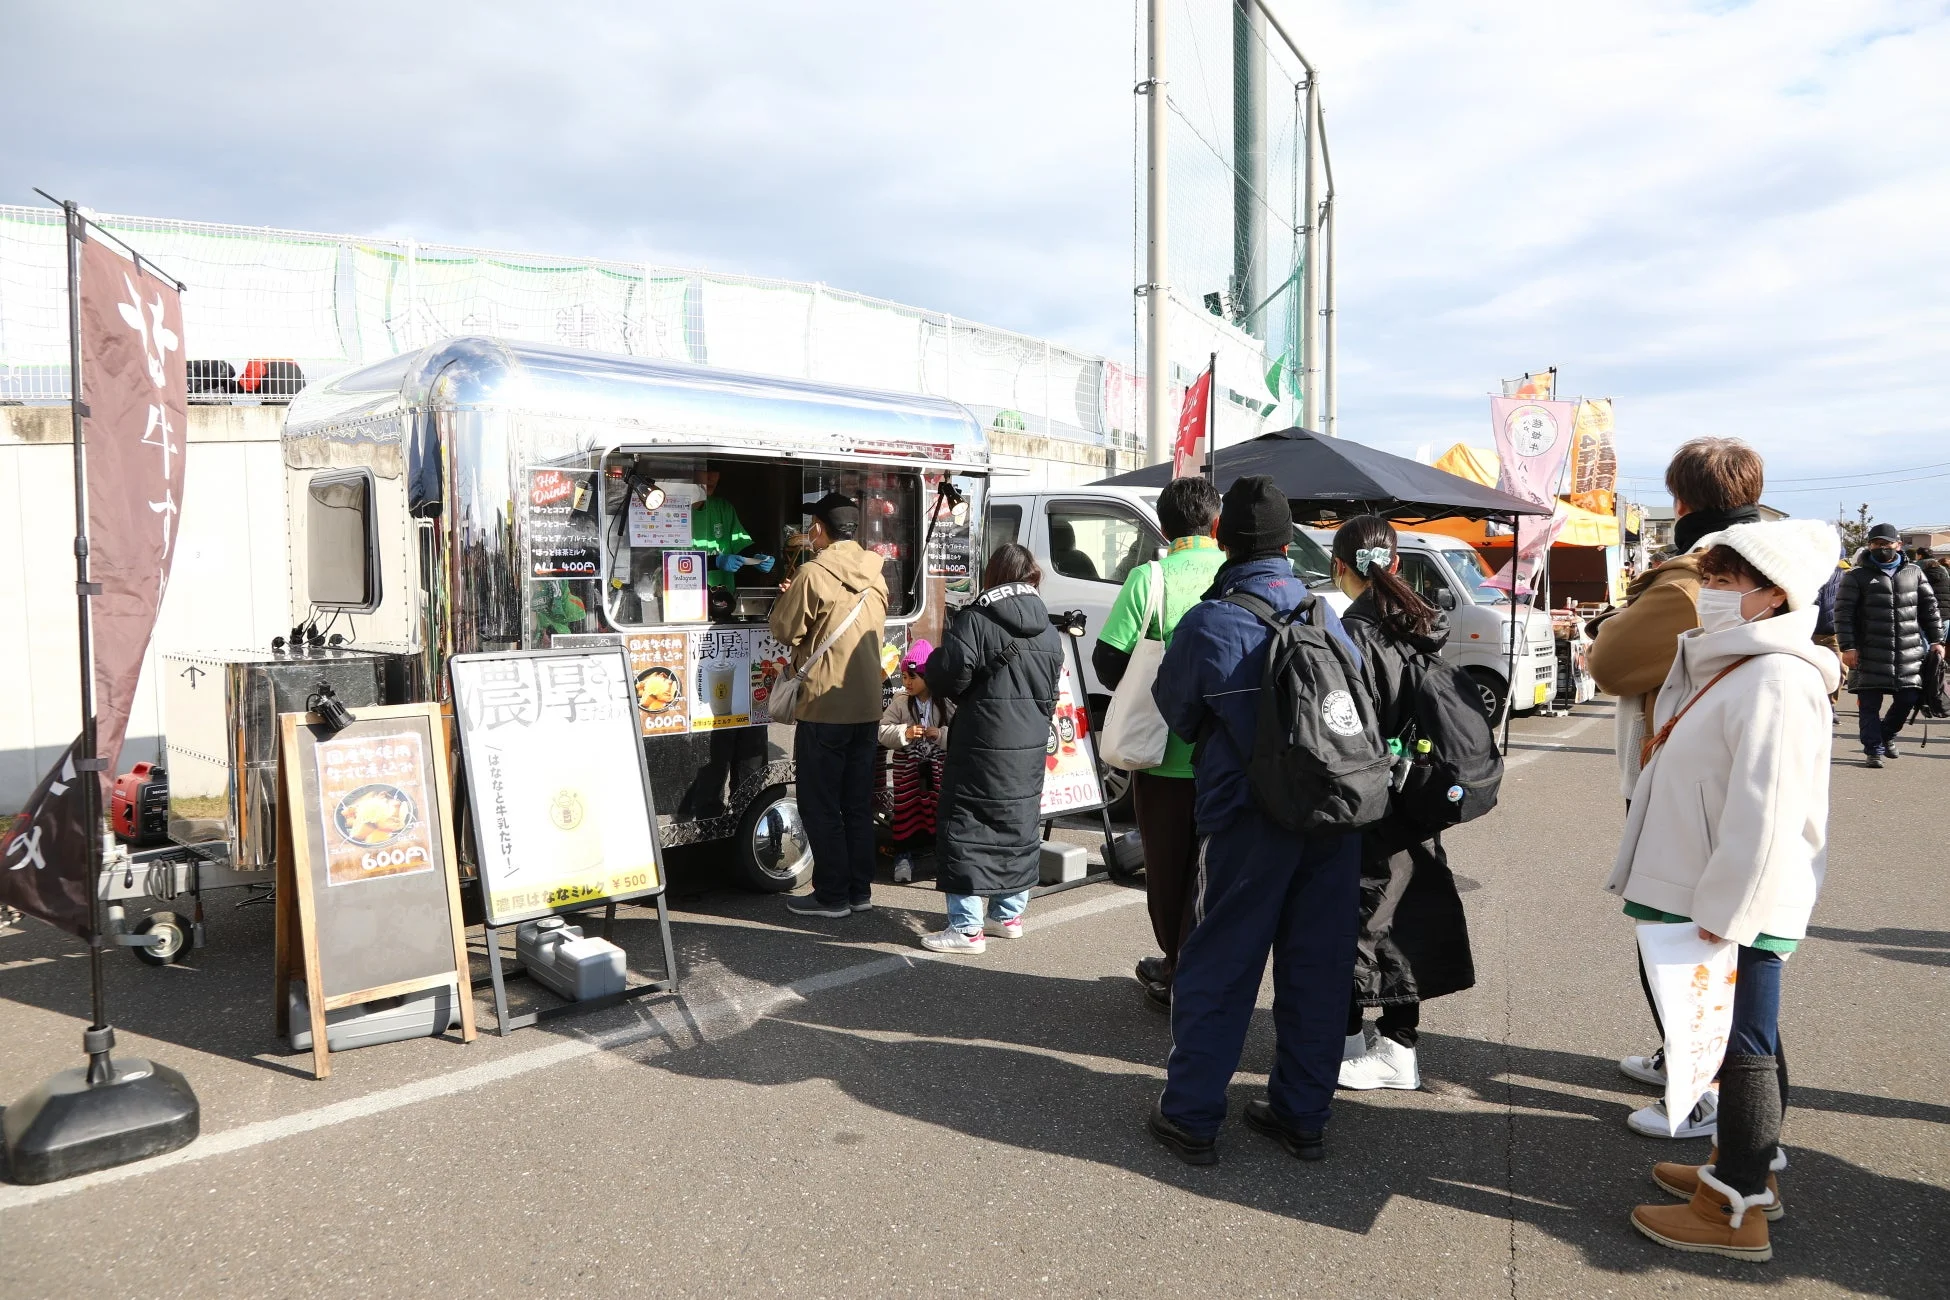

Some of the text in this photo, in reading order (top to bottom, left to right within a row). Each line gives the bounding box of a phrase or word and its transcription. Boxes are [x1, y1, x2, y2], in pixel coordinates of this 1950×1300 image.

[536, 471, 559, 487] Hot
[532, 480, 571, 504] Drink!
[534, 561, 595, 572] ALL 400円
[629, 638, 683, 651] 国産牛使用
[692, 631, 738, 660] 濃厚
[457, 656, 598, 733] 濃厚
[645, 714, 687, 729] 600円
[361, 845, 430, 871] 600円
